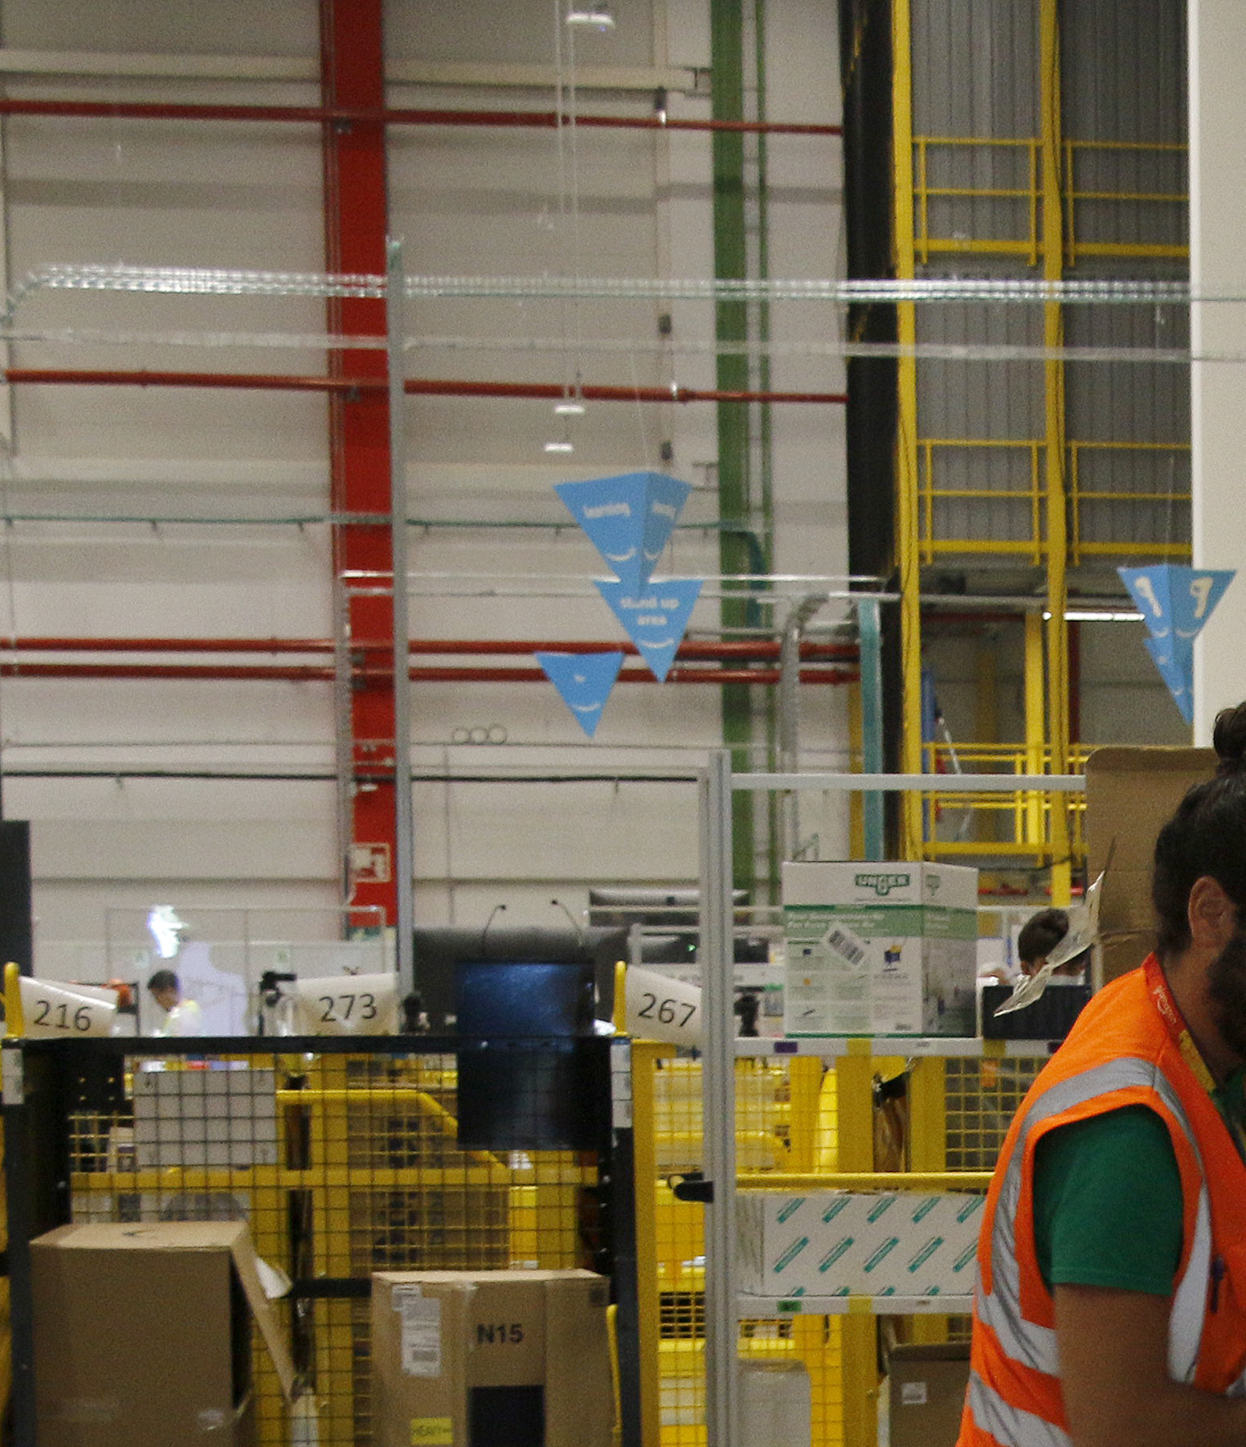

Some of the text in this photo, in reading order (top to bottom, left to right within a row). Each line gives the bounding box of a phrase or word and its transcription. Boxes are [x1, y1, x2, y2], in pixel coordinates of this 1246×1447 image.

[856, 875, 909, 895] UNGER
[33, 1000, 91, 1032] 216
[320, 993, 377, 1023] 273
[638, 993, 697, 1028] 267
[476, 1324, 524, 1345] N15
